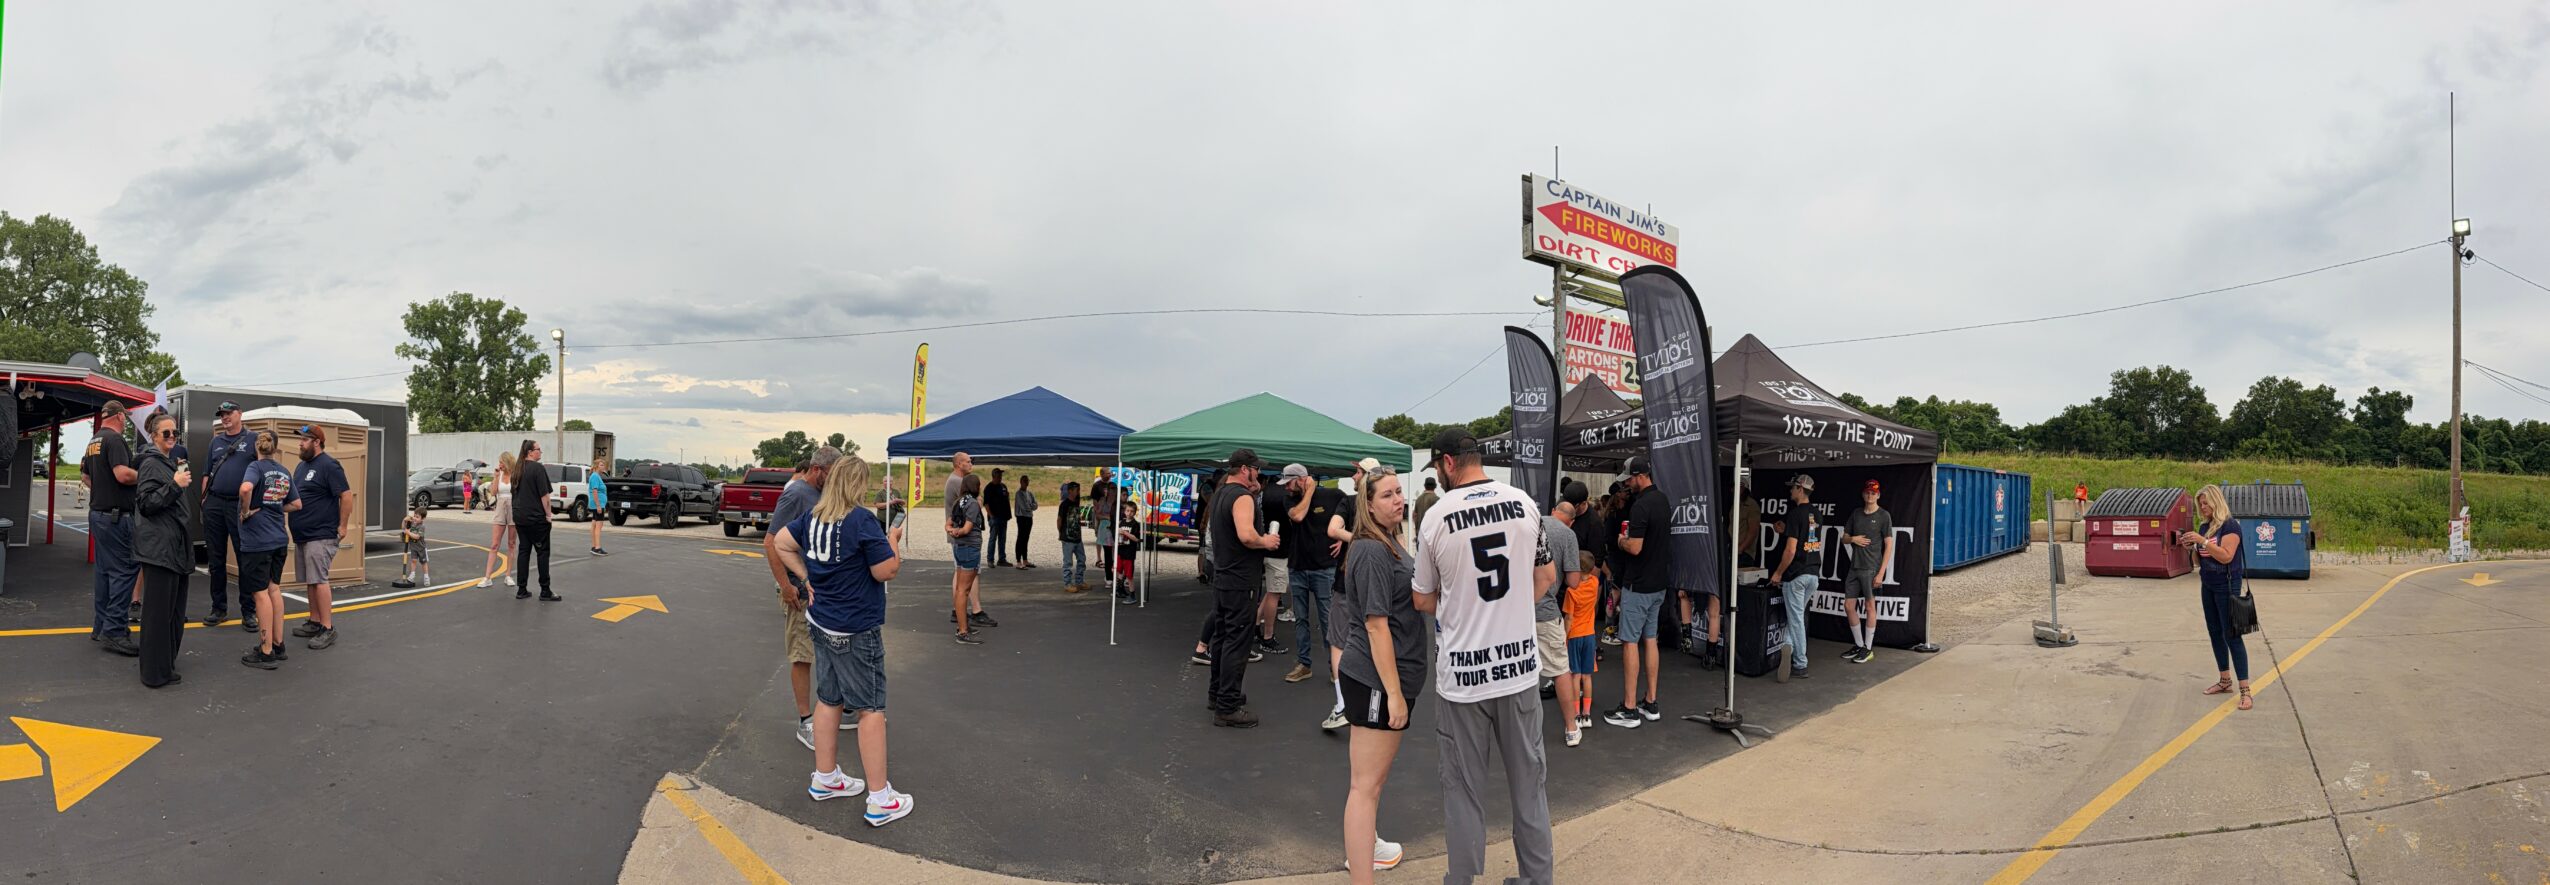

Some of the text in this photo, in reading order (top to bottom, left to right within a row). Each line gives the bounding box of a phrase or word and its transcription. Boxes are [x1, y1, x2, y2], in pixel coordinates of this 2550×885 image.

[1547, 179, 1666, 237] CAPTAIN JIM'S
[1538, 235, 1600, 265] DIRT
[1562, 208, 1674, 264] FIREWORKS
[1566, 311, 1637, 353] DRIVE THR
[1566, 347, 1618, 371] ARTONS
[1484, 440, 1501, 455] THE
[1580, 418, 1641, 446] 105.7 THE
[1783, 414, 1915, 451] 105.7 THE POINT
[1444, 500, 1525, 535] TIMMINS
[1760, 498, 1788, 515] 105
[807, 516, 834, 562] 10
[835, 519, 843, 562] ULISIC
[1470, 531, 1510, 603] 5
[1816, 594, 1906, 617] ALTENIVE
[1449, 647, 1492, 667] THANK
[1494, 641, 1521, 661] YOU
[1454, 668, 1490, 687] YOUR
